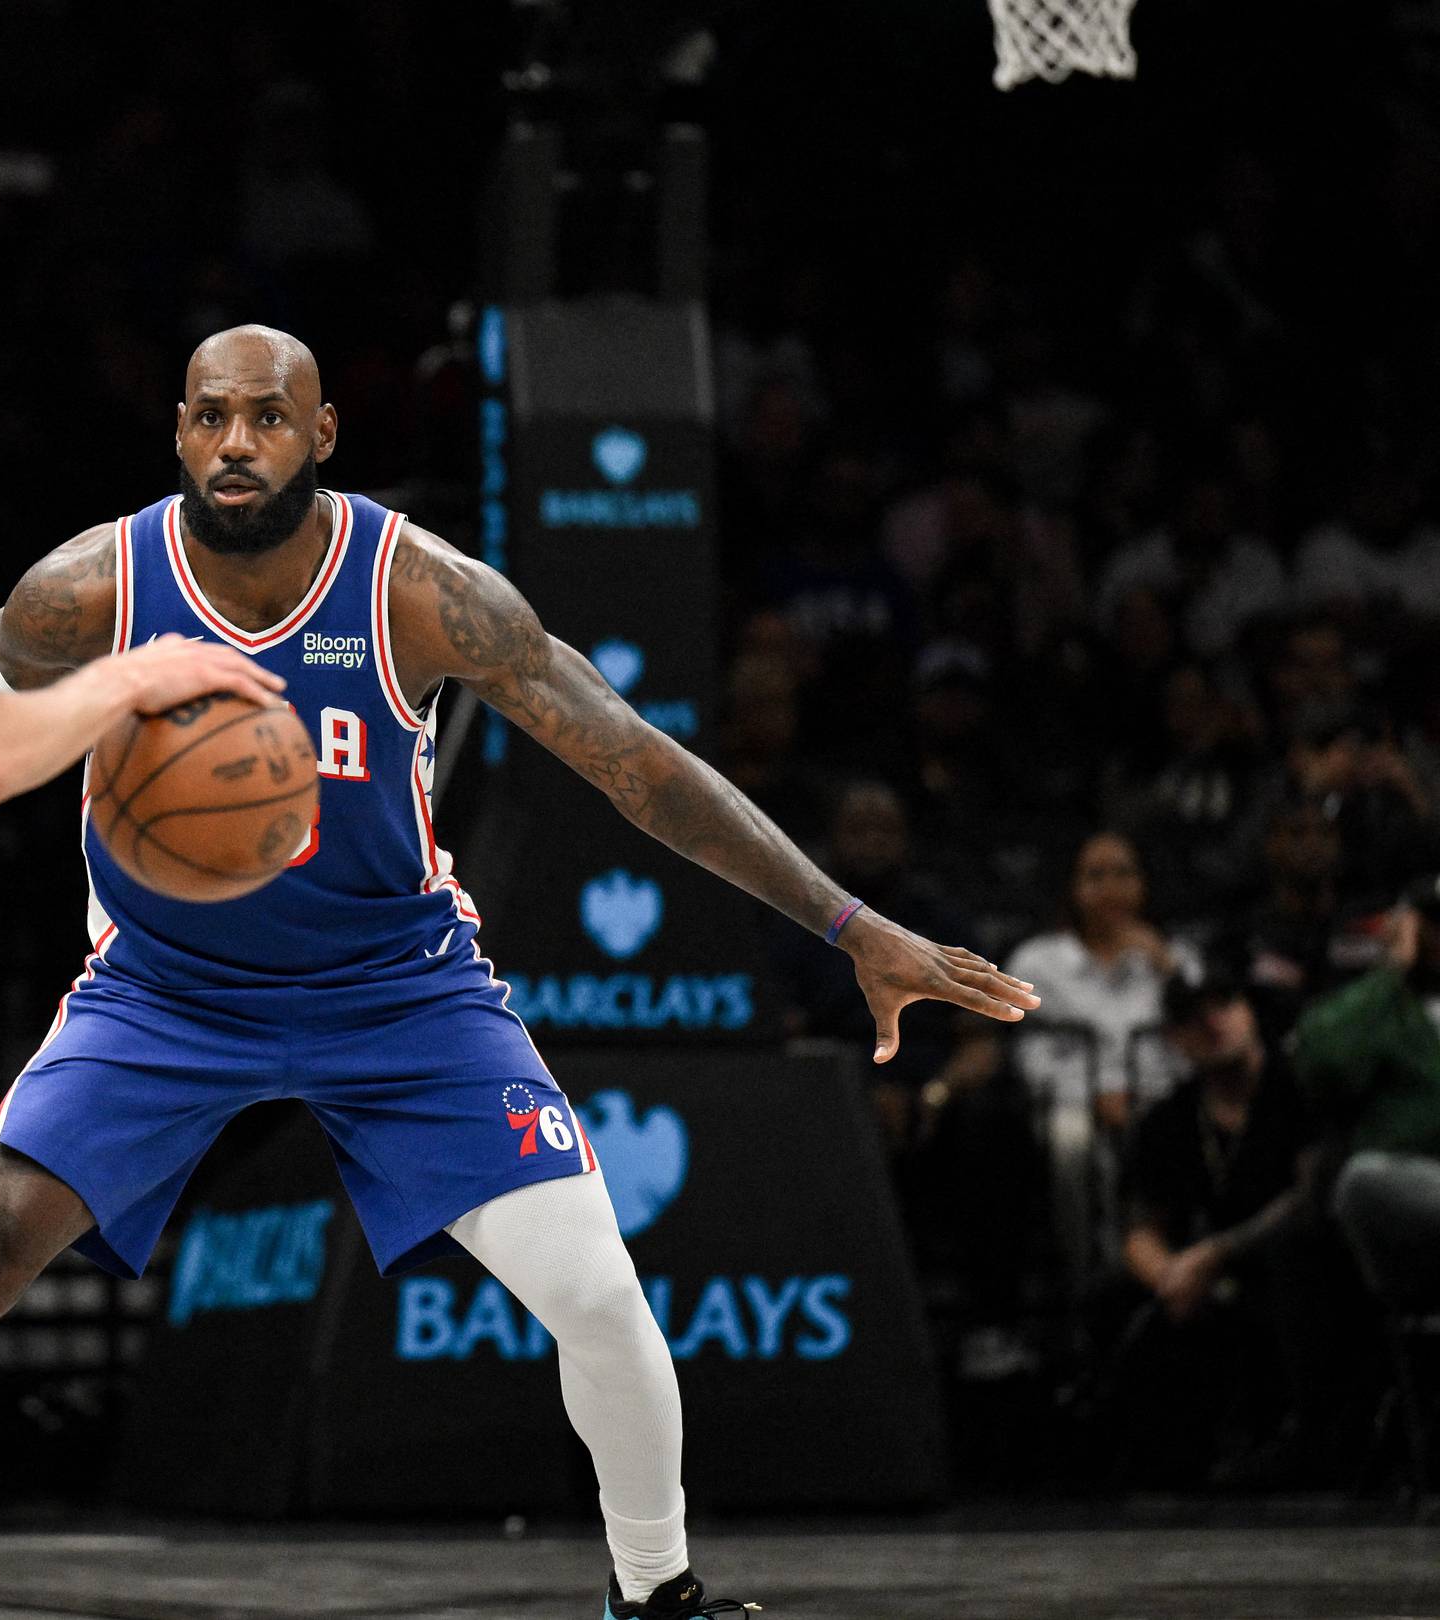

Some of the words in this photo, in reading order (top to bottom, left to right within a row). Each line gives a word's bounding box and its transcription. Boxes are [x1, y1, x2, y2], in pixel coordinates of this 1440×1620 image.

[303, 632, 366, 651] Bloom
[303, 652, 366, 668] energy
[496, 972, 755, 1030] BARCLAYS
[506, 1105, 574, 1158] 76
[395, 1273, 854, 1361] BALAYS
